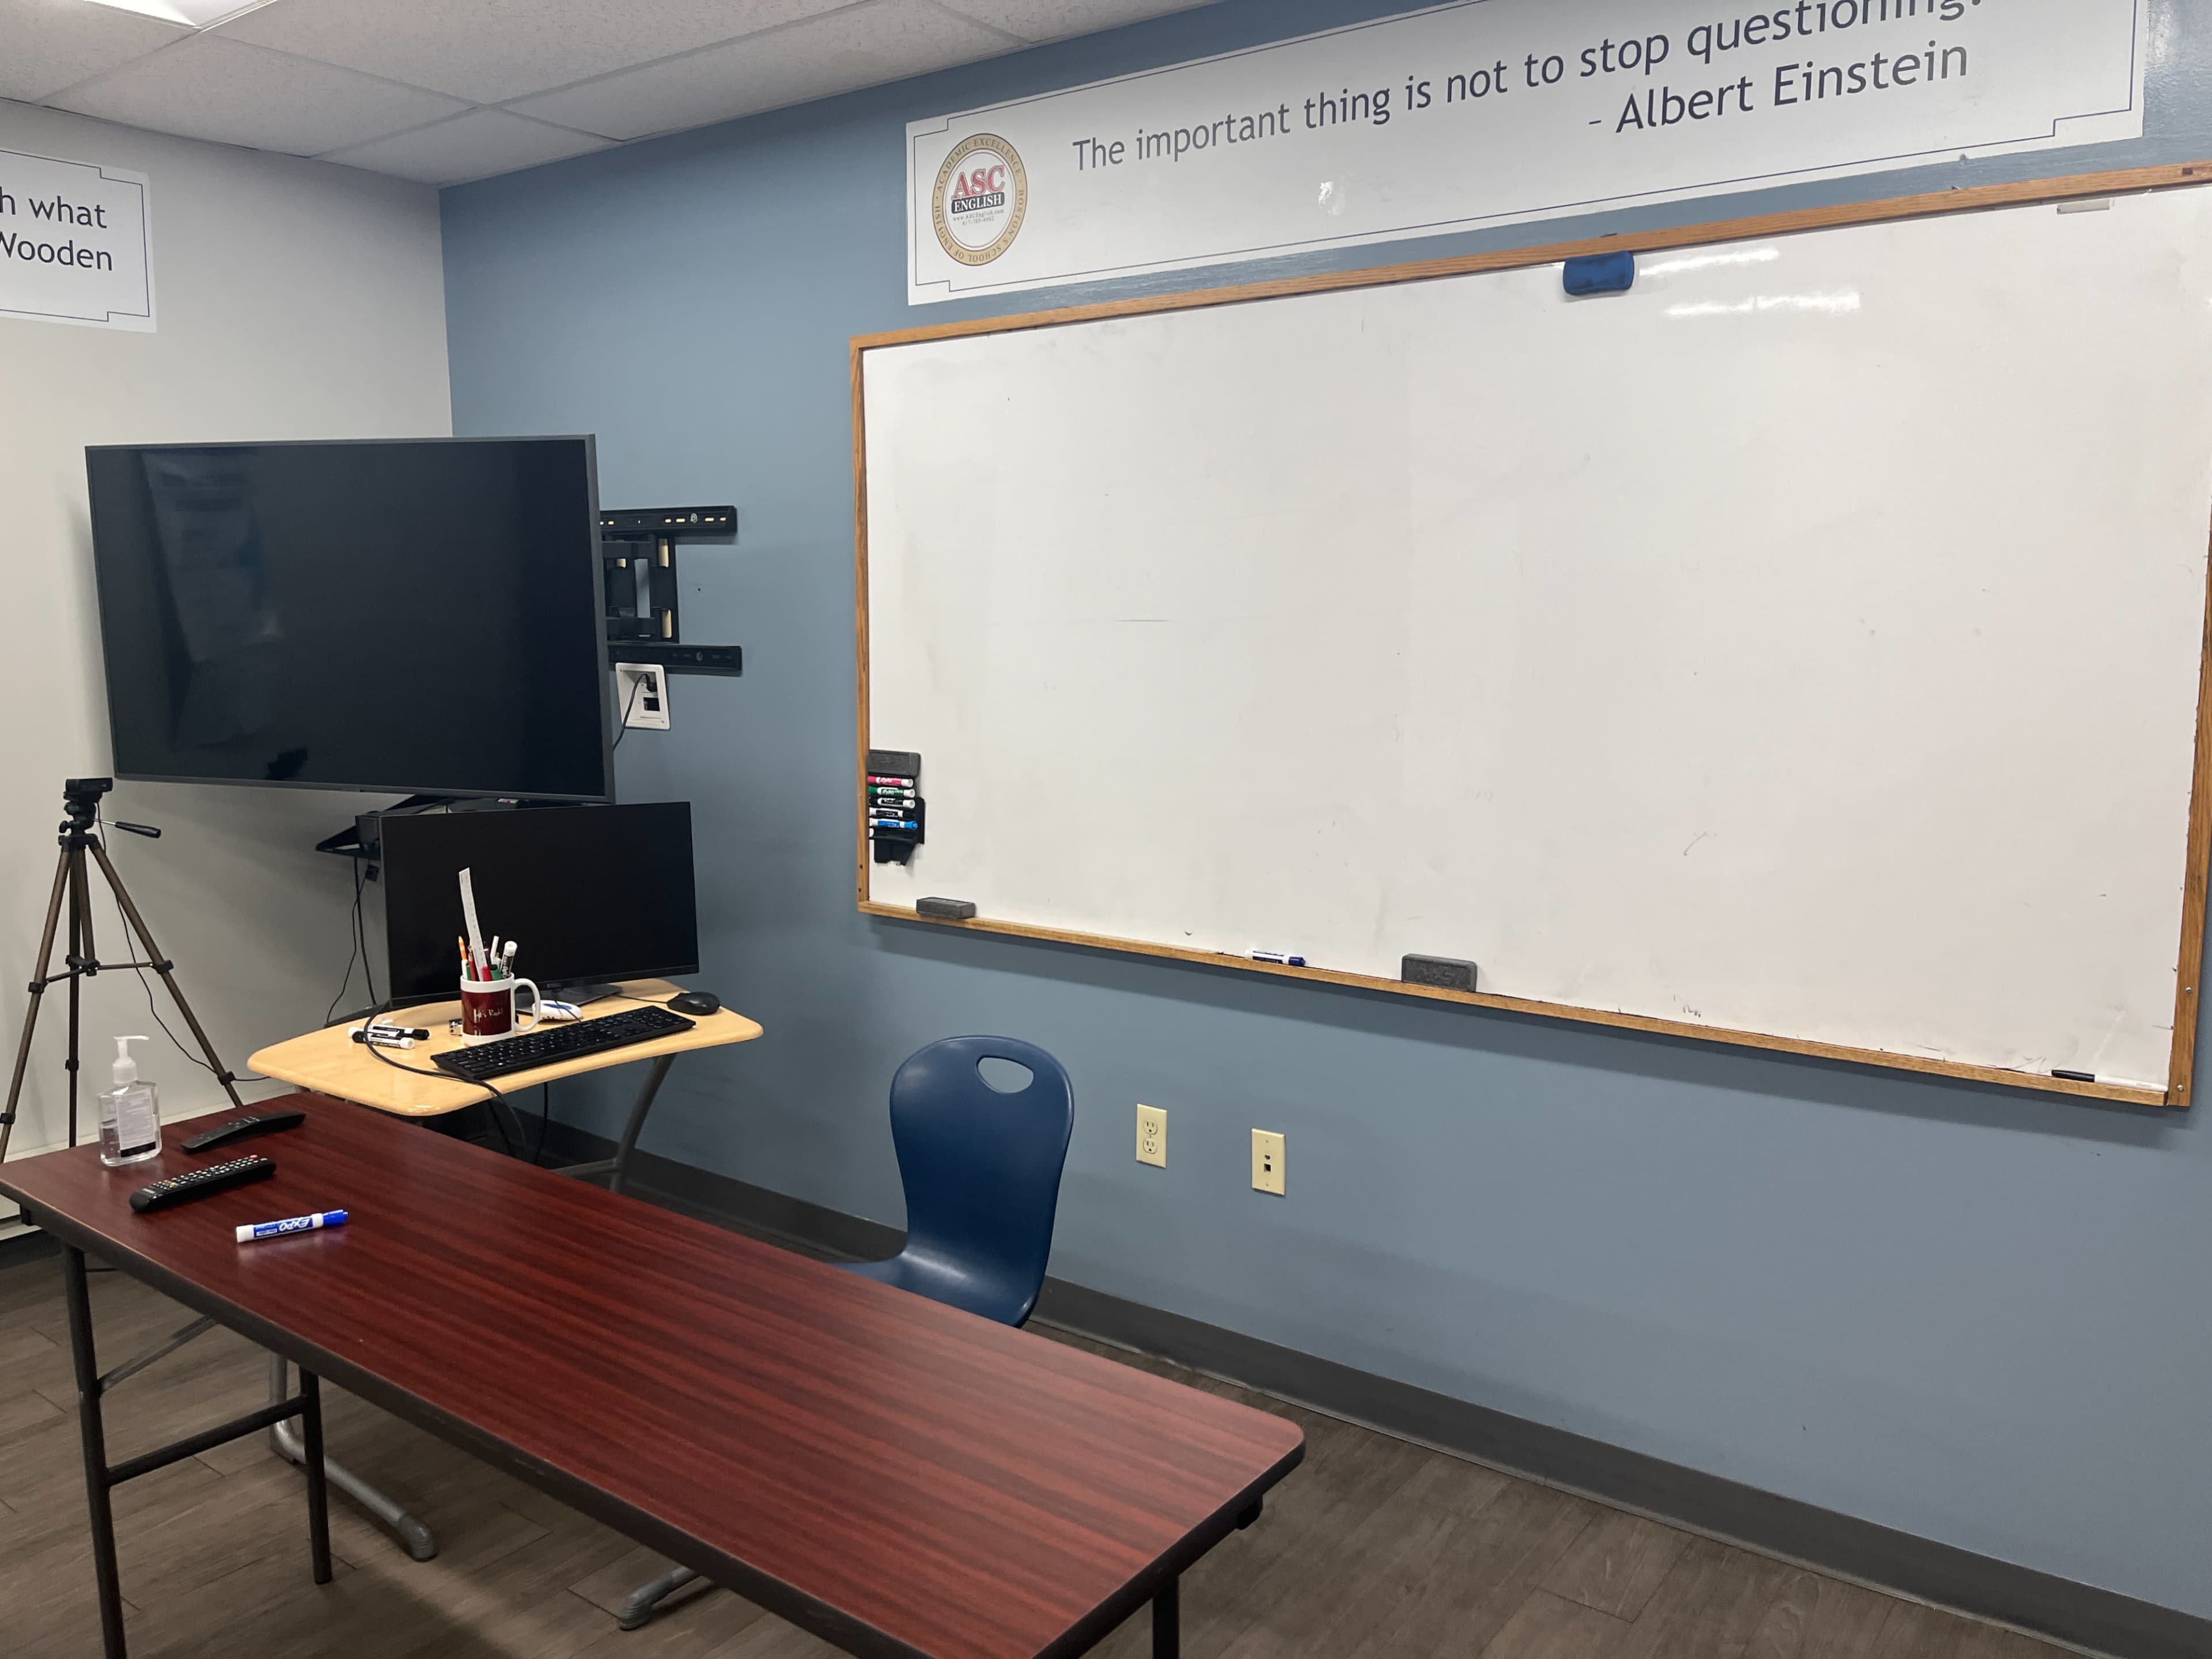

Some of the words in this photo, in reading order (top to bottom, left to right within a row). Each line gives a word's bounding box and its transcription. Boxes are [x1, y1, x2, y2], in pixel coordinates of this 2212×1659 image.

[1615, 76, 1754, 133] Albert
[1774, 40, 1967, 106] Einstein
[1072, 137, 1125, 171] The
[1136, 104, 1291, 162] important
[1304, 88, 1391, 125] thing
[1405, 75, 1431, 110] is
[1446, 60, 1508, 103] not
[1524, 54, 1565, 87] to
[1580, 38, 1670, 75] stop
[937, 141, 971, 192] ACADEMIC
[974, 138, 1022, 176] EXCELLENCE
[951, 165, 1005, 200] ASC
[28, 195, 107, 229] what
[954, 194, 1002, 213] ENGLISH
[934, 206, 953, 251] ENGLISH
[953, 249, 965, 260] OF
[968, 244, 1002, 263] SCHOOL
[279, 1218, 310, 1232] EXPO
